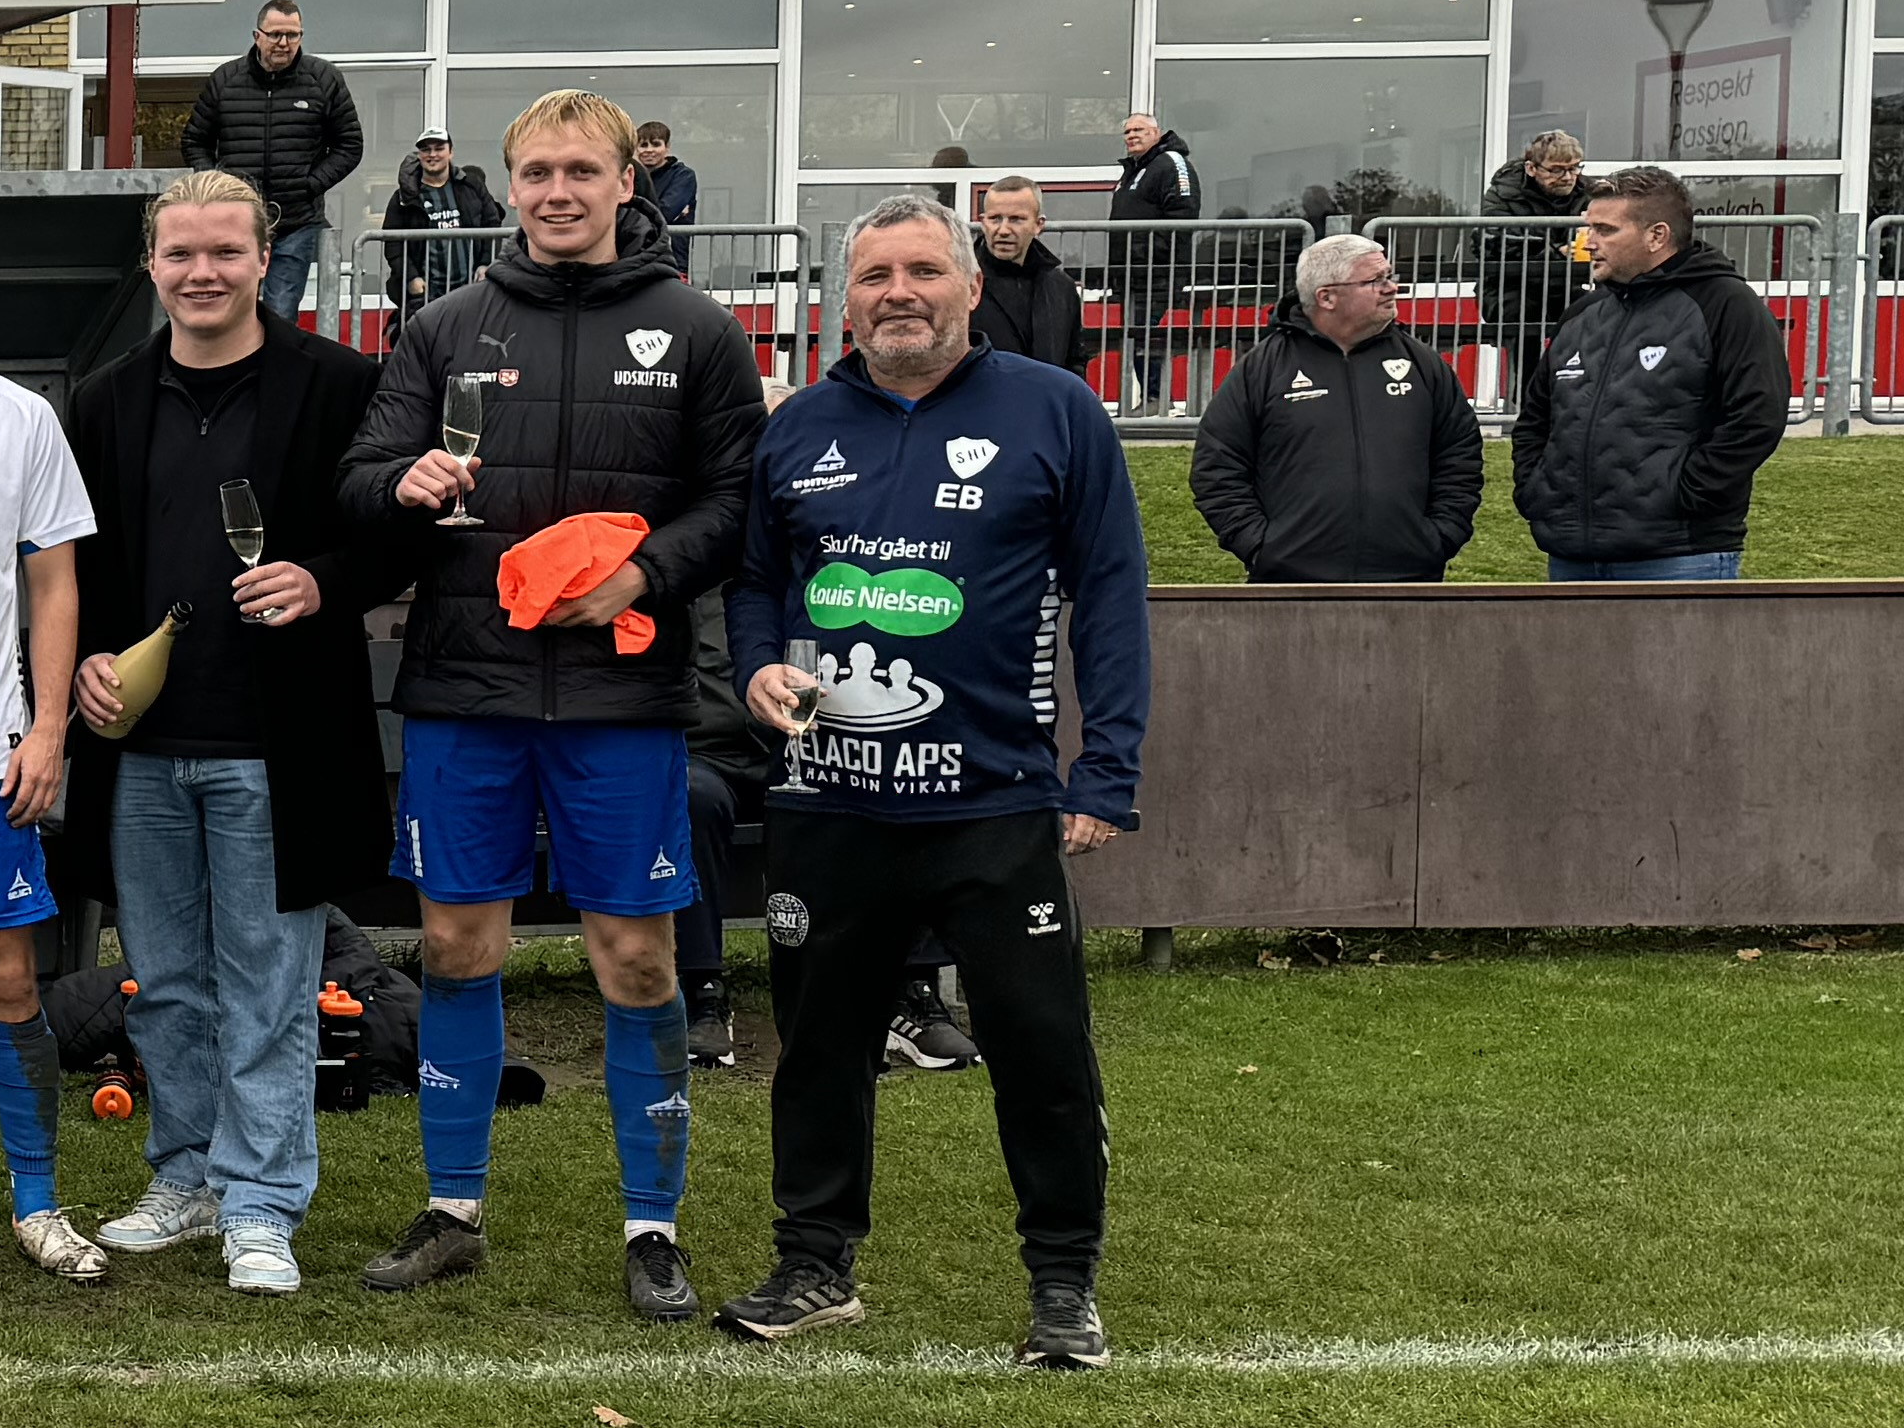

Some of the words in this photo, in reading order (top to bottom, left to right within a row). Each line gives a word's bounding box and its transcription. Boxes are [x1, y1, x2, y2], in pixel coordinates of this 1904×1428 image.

[1670, 68, 1754, 108] Respekt
[1670, 118, 1748, 151] Passion
[636, 337, 663, 355] SHI
[614, 371, 678, 388] UDSKIFTER
[1385, 382, 1412, 396] CP
[956, 447, 987, 463] SHI
[935, 483, 983, 510] EB
[880, 537, 926, 560] gået
[931, 540, 951, 561] til
[810, 583, 855, 607] Louis
[894, 743, 962, 777] APS
[806, 767, 840, 784] HAR
[850, 775, 880, 792] DIN
[894, 780, 960, 794] VIKAR
